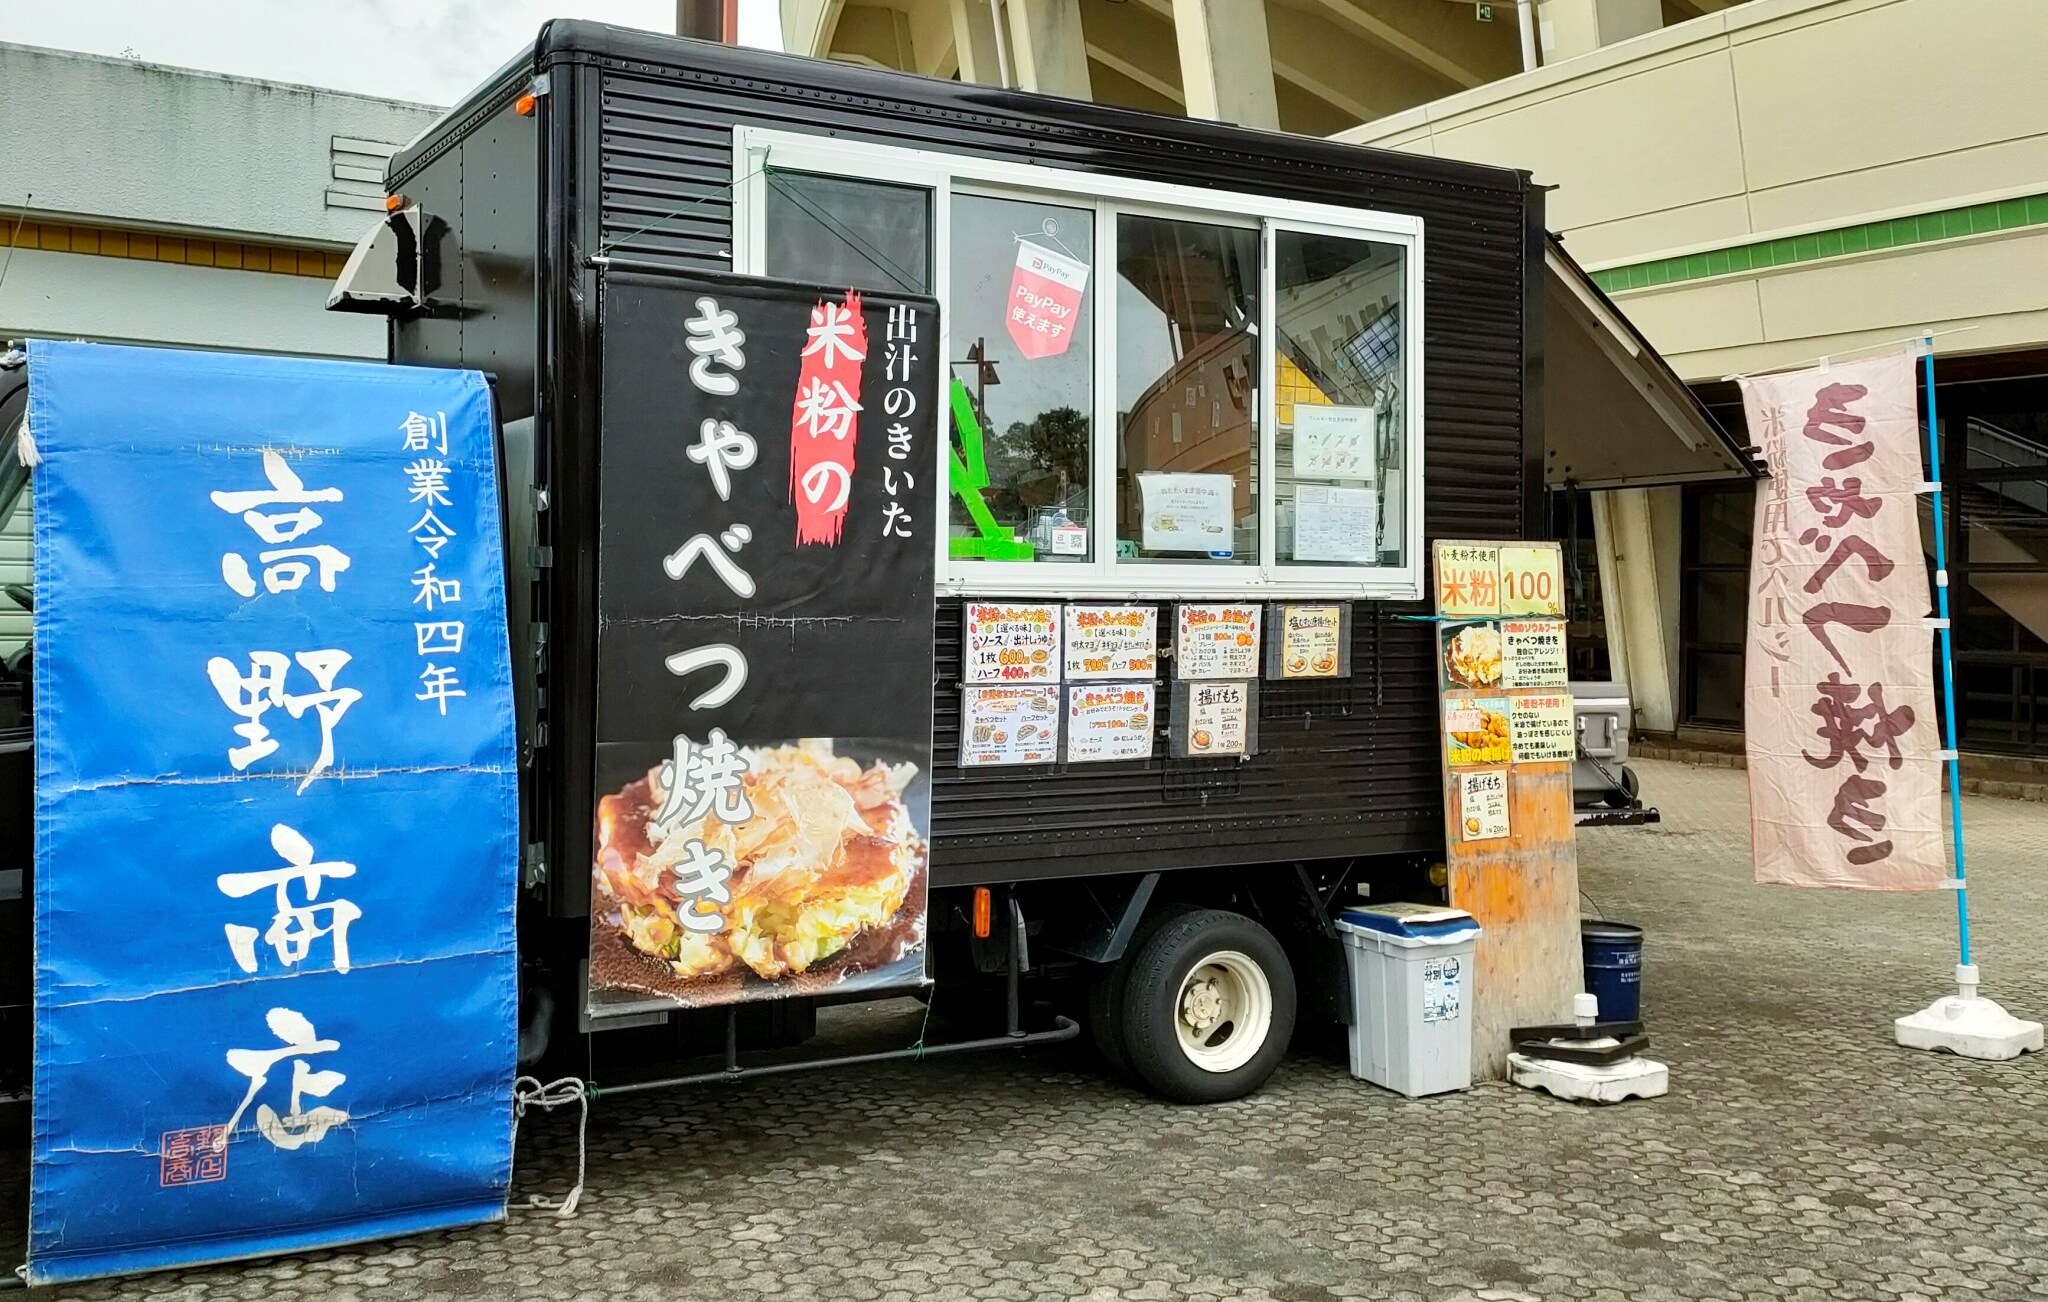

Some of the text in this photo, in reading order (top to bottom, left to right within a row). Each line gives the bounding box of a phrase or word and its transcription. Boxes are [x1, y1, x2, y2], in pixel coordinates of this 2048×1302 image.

[1043, 262, 1070, 280] PayPay
[1015, 285, 1071, 319] PayPay
[1011, 305, 1066, 338] 使えます
[796, 300, 866, 514] 米粉の
[882, 304, 919, 539] 出汁のきいた
[398, 410, 467, 717] 創業令和四年
[1441, 549, 1496, 562] 小麦粉不使用
[1442, 568, 1496, 607] 米粉
[1504, 571, 1551, 600] 100
[979, 635, 1003, 646] ソース
[1508, 636, 1559, 646] きゃべつ焼きを
[980, 647, 1030, 665] 1枚 600円
[977, 666, 1029, 680] ハーフ 400円
[1085, 691, 1145, 706] きゃべつ焼き
[1198, 689, 1239, 705] 揚げもち
[1468, 776, 1500, 792] 揚げもち
[206, 453, 362, 1151] 高野商店
